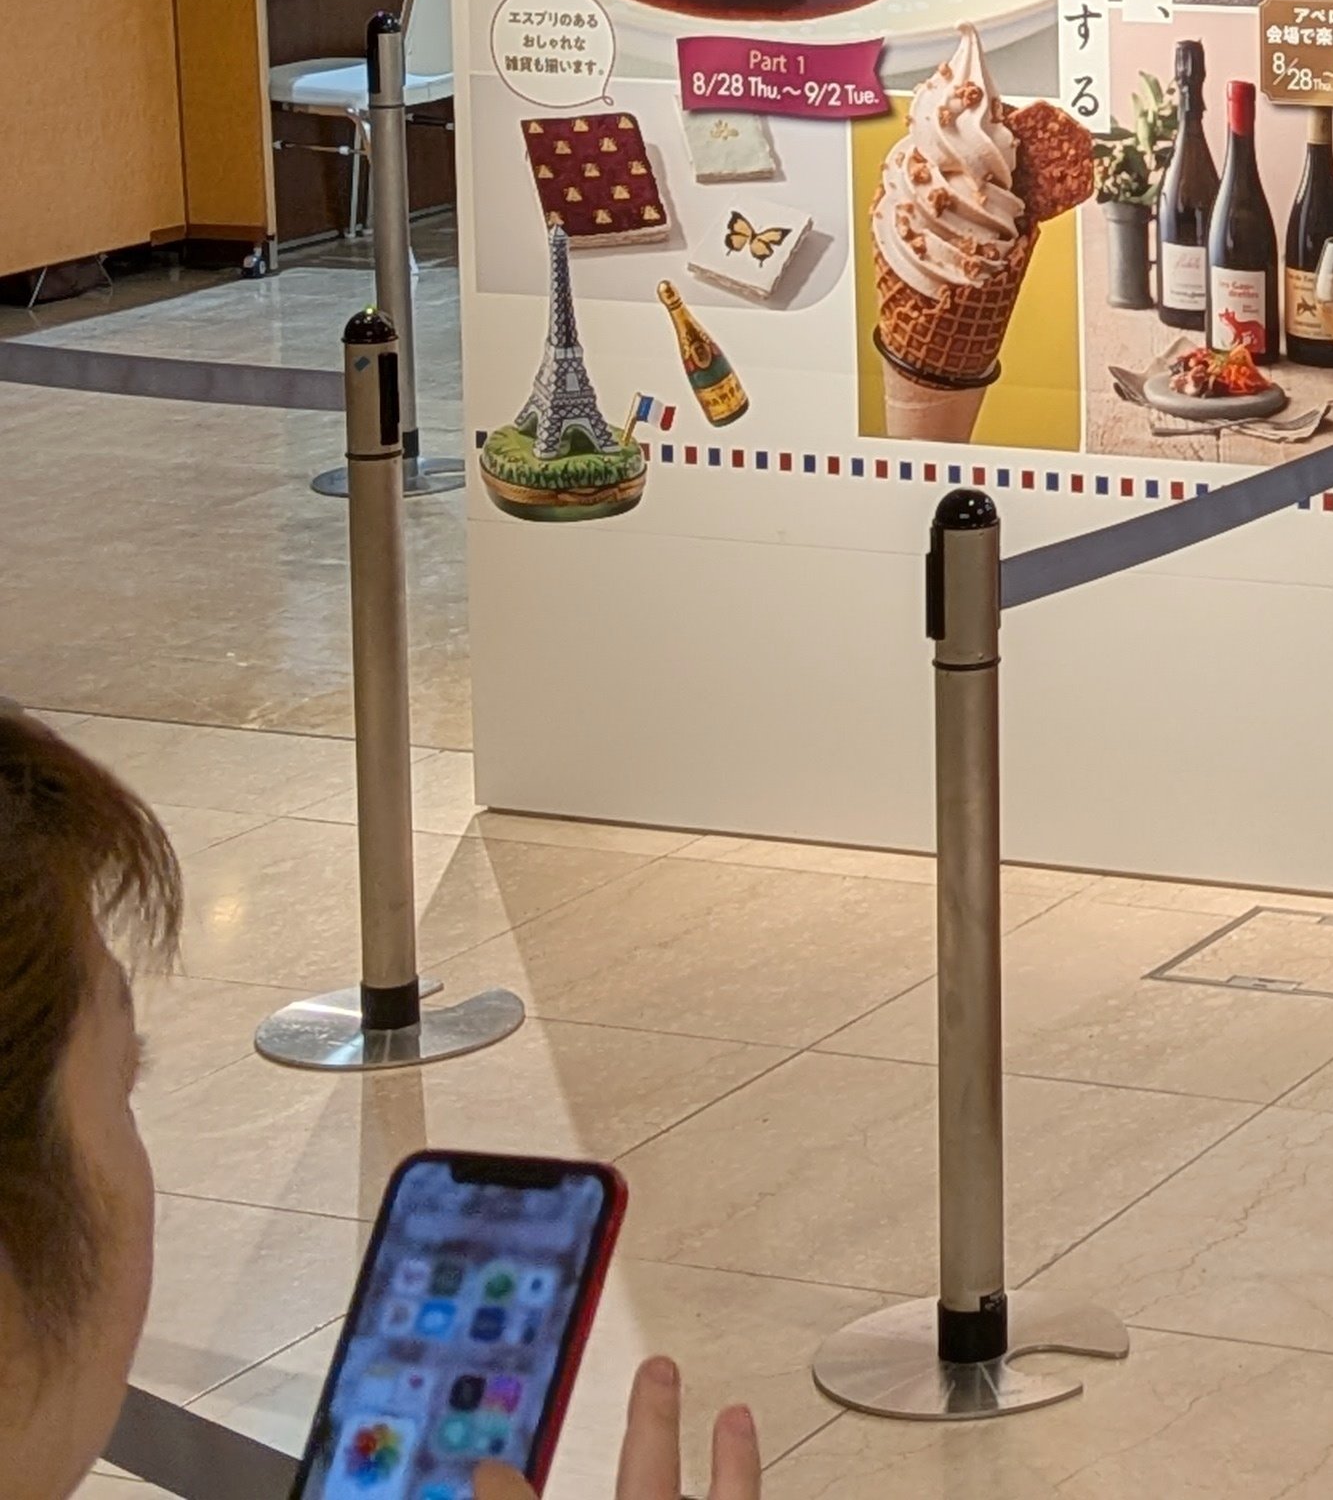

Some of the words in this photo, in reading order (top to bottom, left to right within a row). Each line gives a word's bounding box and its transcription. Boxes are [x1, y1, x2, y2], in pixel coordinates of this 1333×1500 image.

[508, 10, 599, 29] エスプリのある
[522, 34, 586, 52] おしゃれな
[749, 50, 788, 74] Part
[796, 55, 806, 75] 1
[692, 72, 744, 97] 8/28
[844, 84, 880, 105] Tue.
